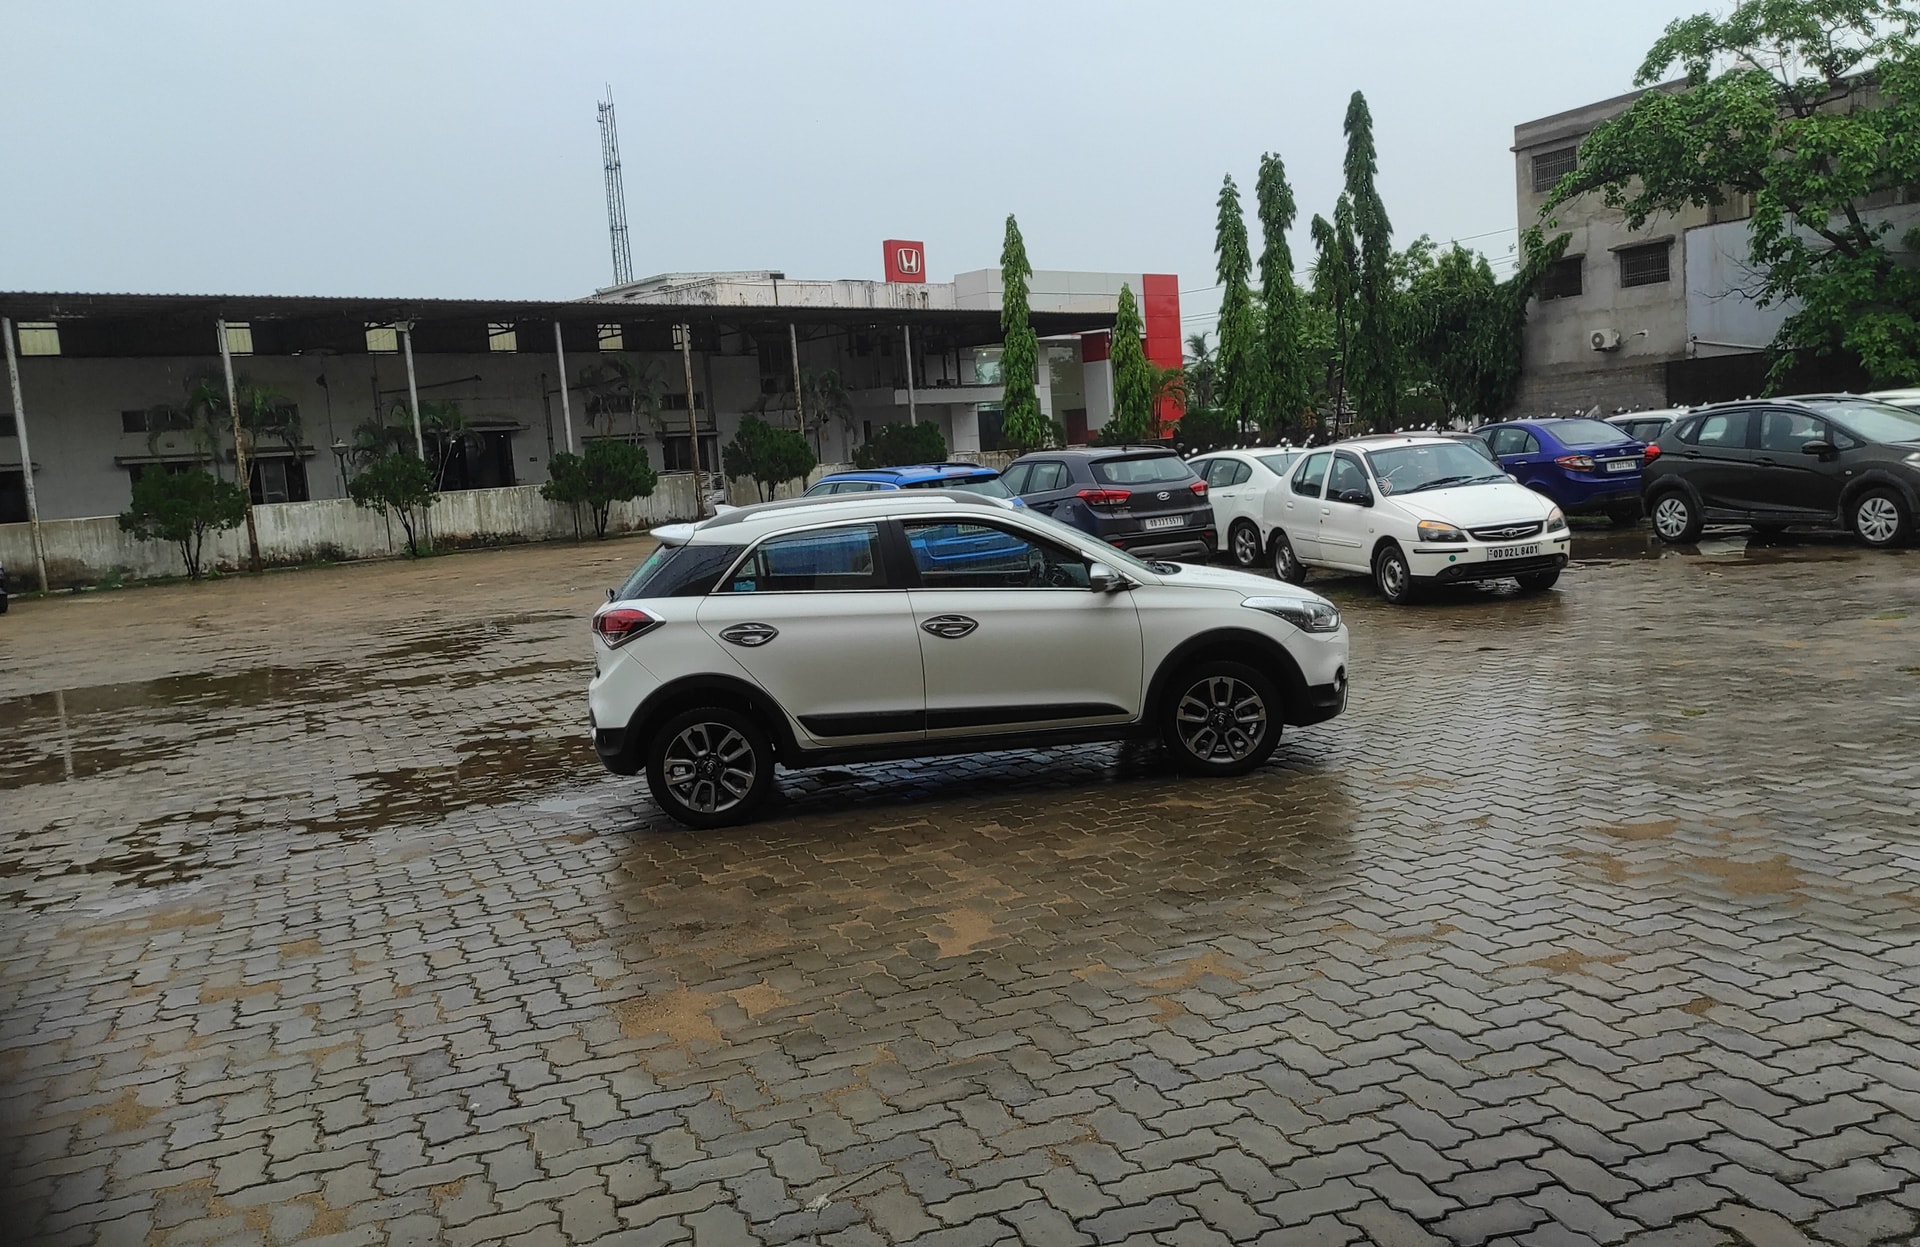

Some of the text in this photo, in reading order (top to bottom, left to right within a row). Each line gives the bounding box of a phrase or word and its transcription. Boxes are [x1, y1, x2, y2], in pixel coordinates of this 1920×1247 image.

[1493, 545, 1538, 558] OD 02 L 8401
